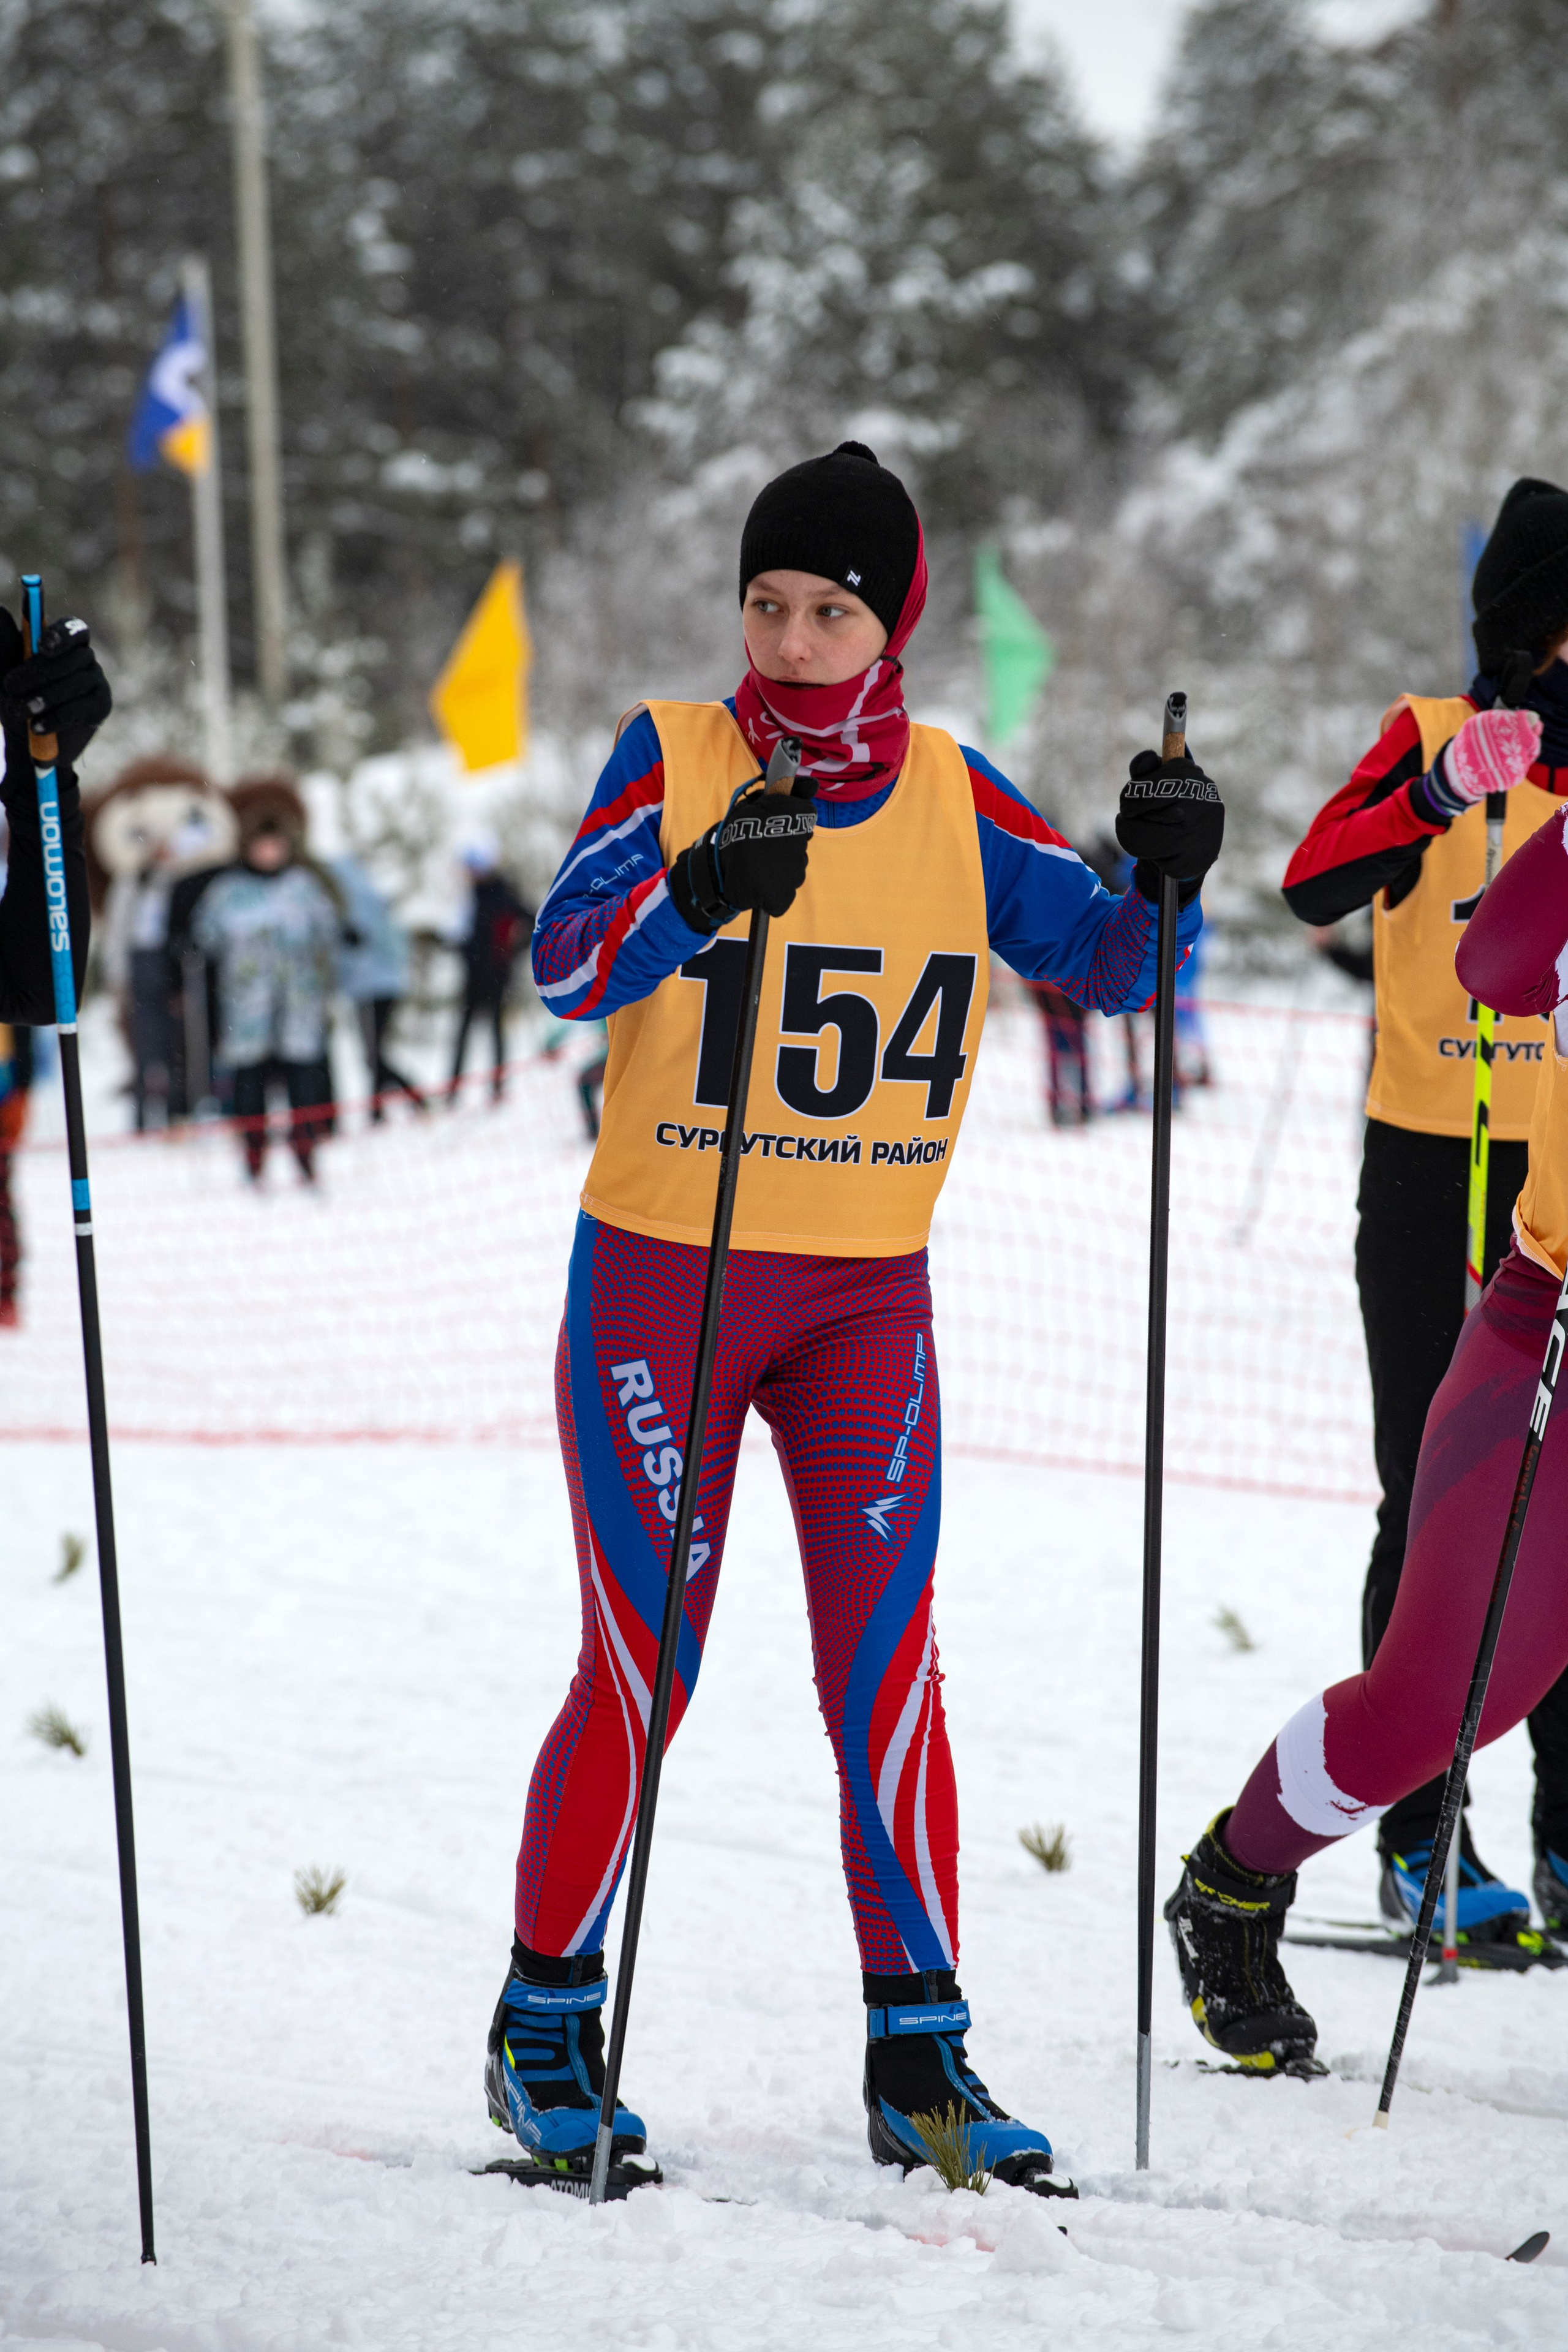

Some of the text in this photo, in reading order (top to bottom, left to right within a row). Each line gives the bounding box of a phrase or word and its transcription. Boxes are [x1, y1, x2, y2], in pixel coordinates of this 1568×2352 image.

[583, 854, 644, 898] -OLIMP
[676, 937, 978, 1121] 154
[870, 1135, 949, 1165] РАЙОН
[527, 1992, 601, 2005] SPINE
[899, 2011, 967, 2025] SPINE
[551, 2179, 592, 2200] ATOMI
